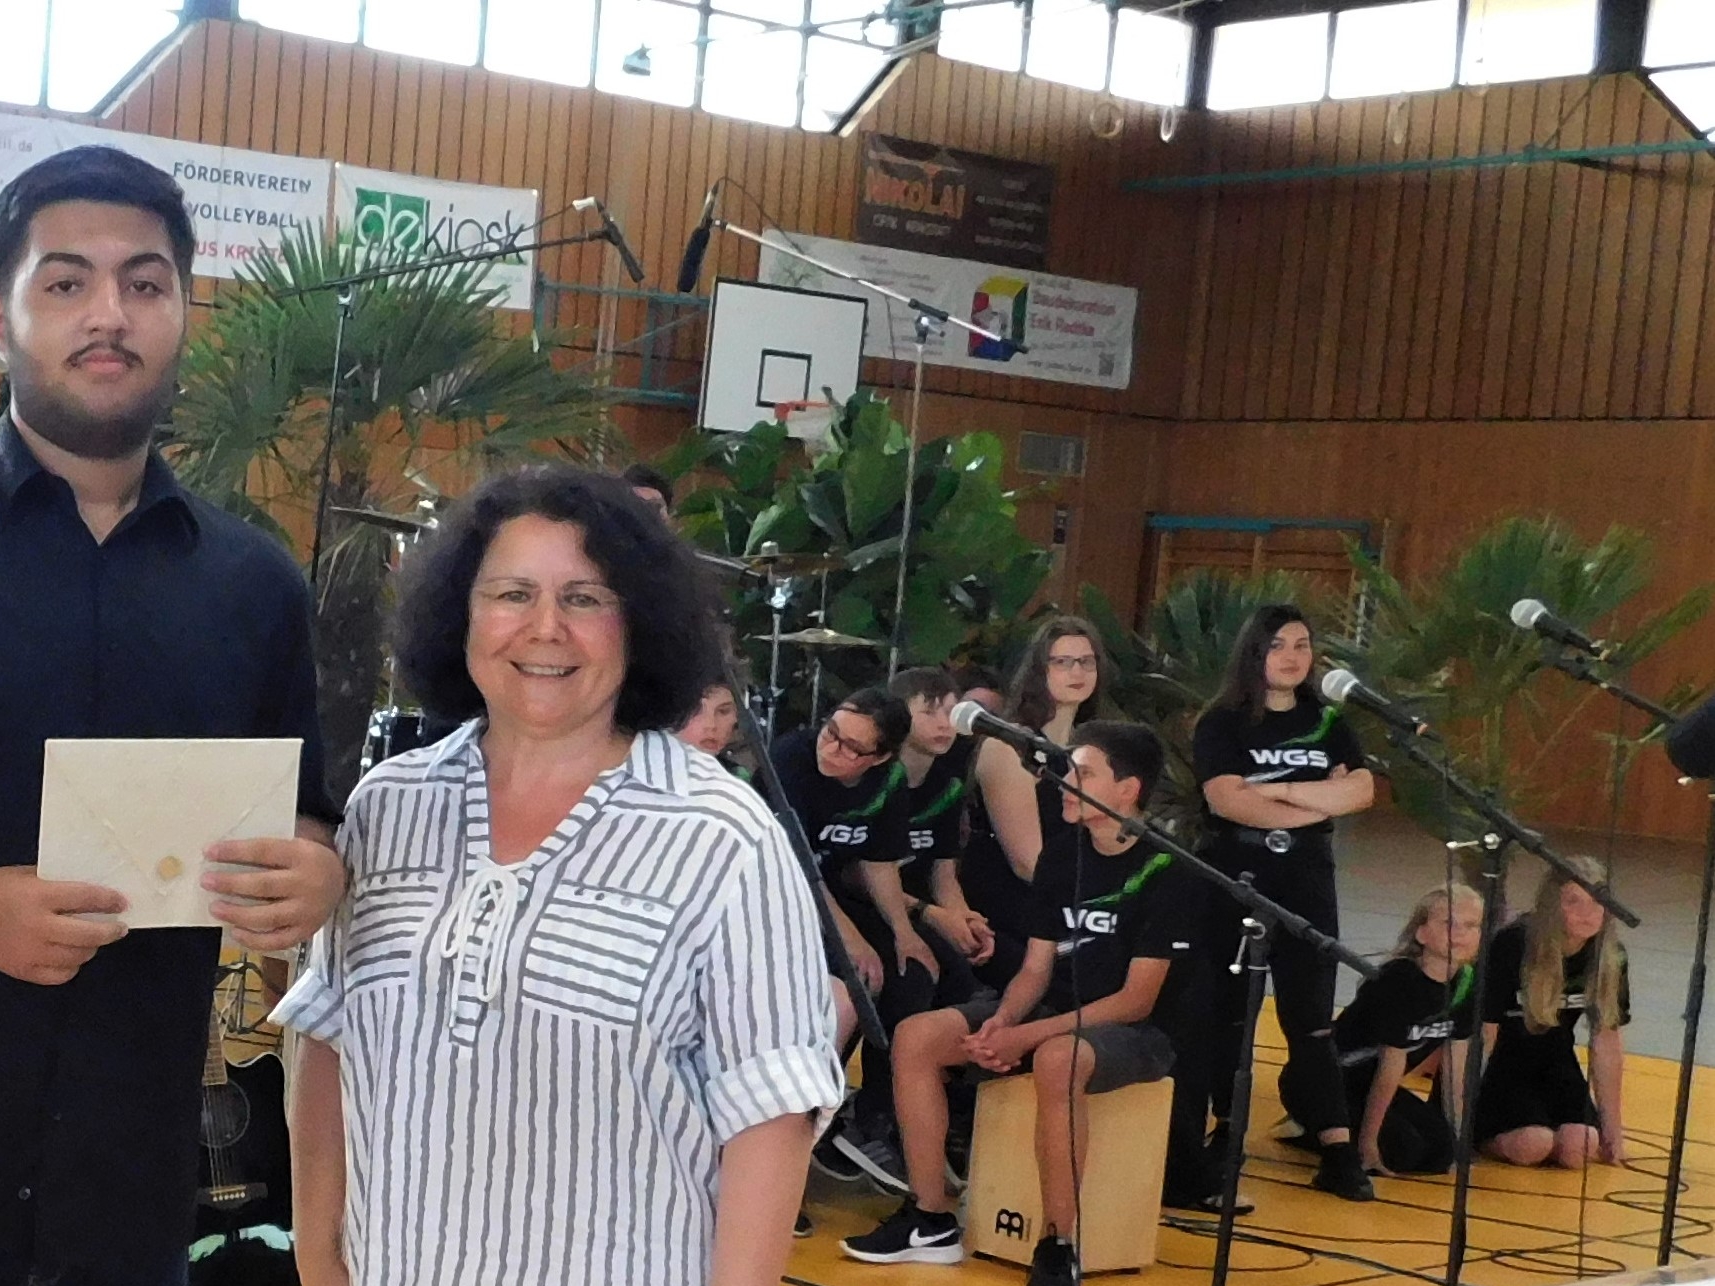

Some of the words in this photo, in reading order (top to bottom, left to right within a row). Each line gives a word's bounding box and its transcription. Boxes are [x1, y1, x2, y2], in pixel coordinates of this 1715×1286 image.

[173, 158, 312, 194] FÖRDERVEREIN
[187, 201, 299, 229] VOLLEYBALL
[196, 240, 218, 257] US
[1249, 748, 1329, 769] WGS
